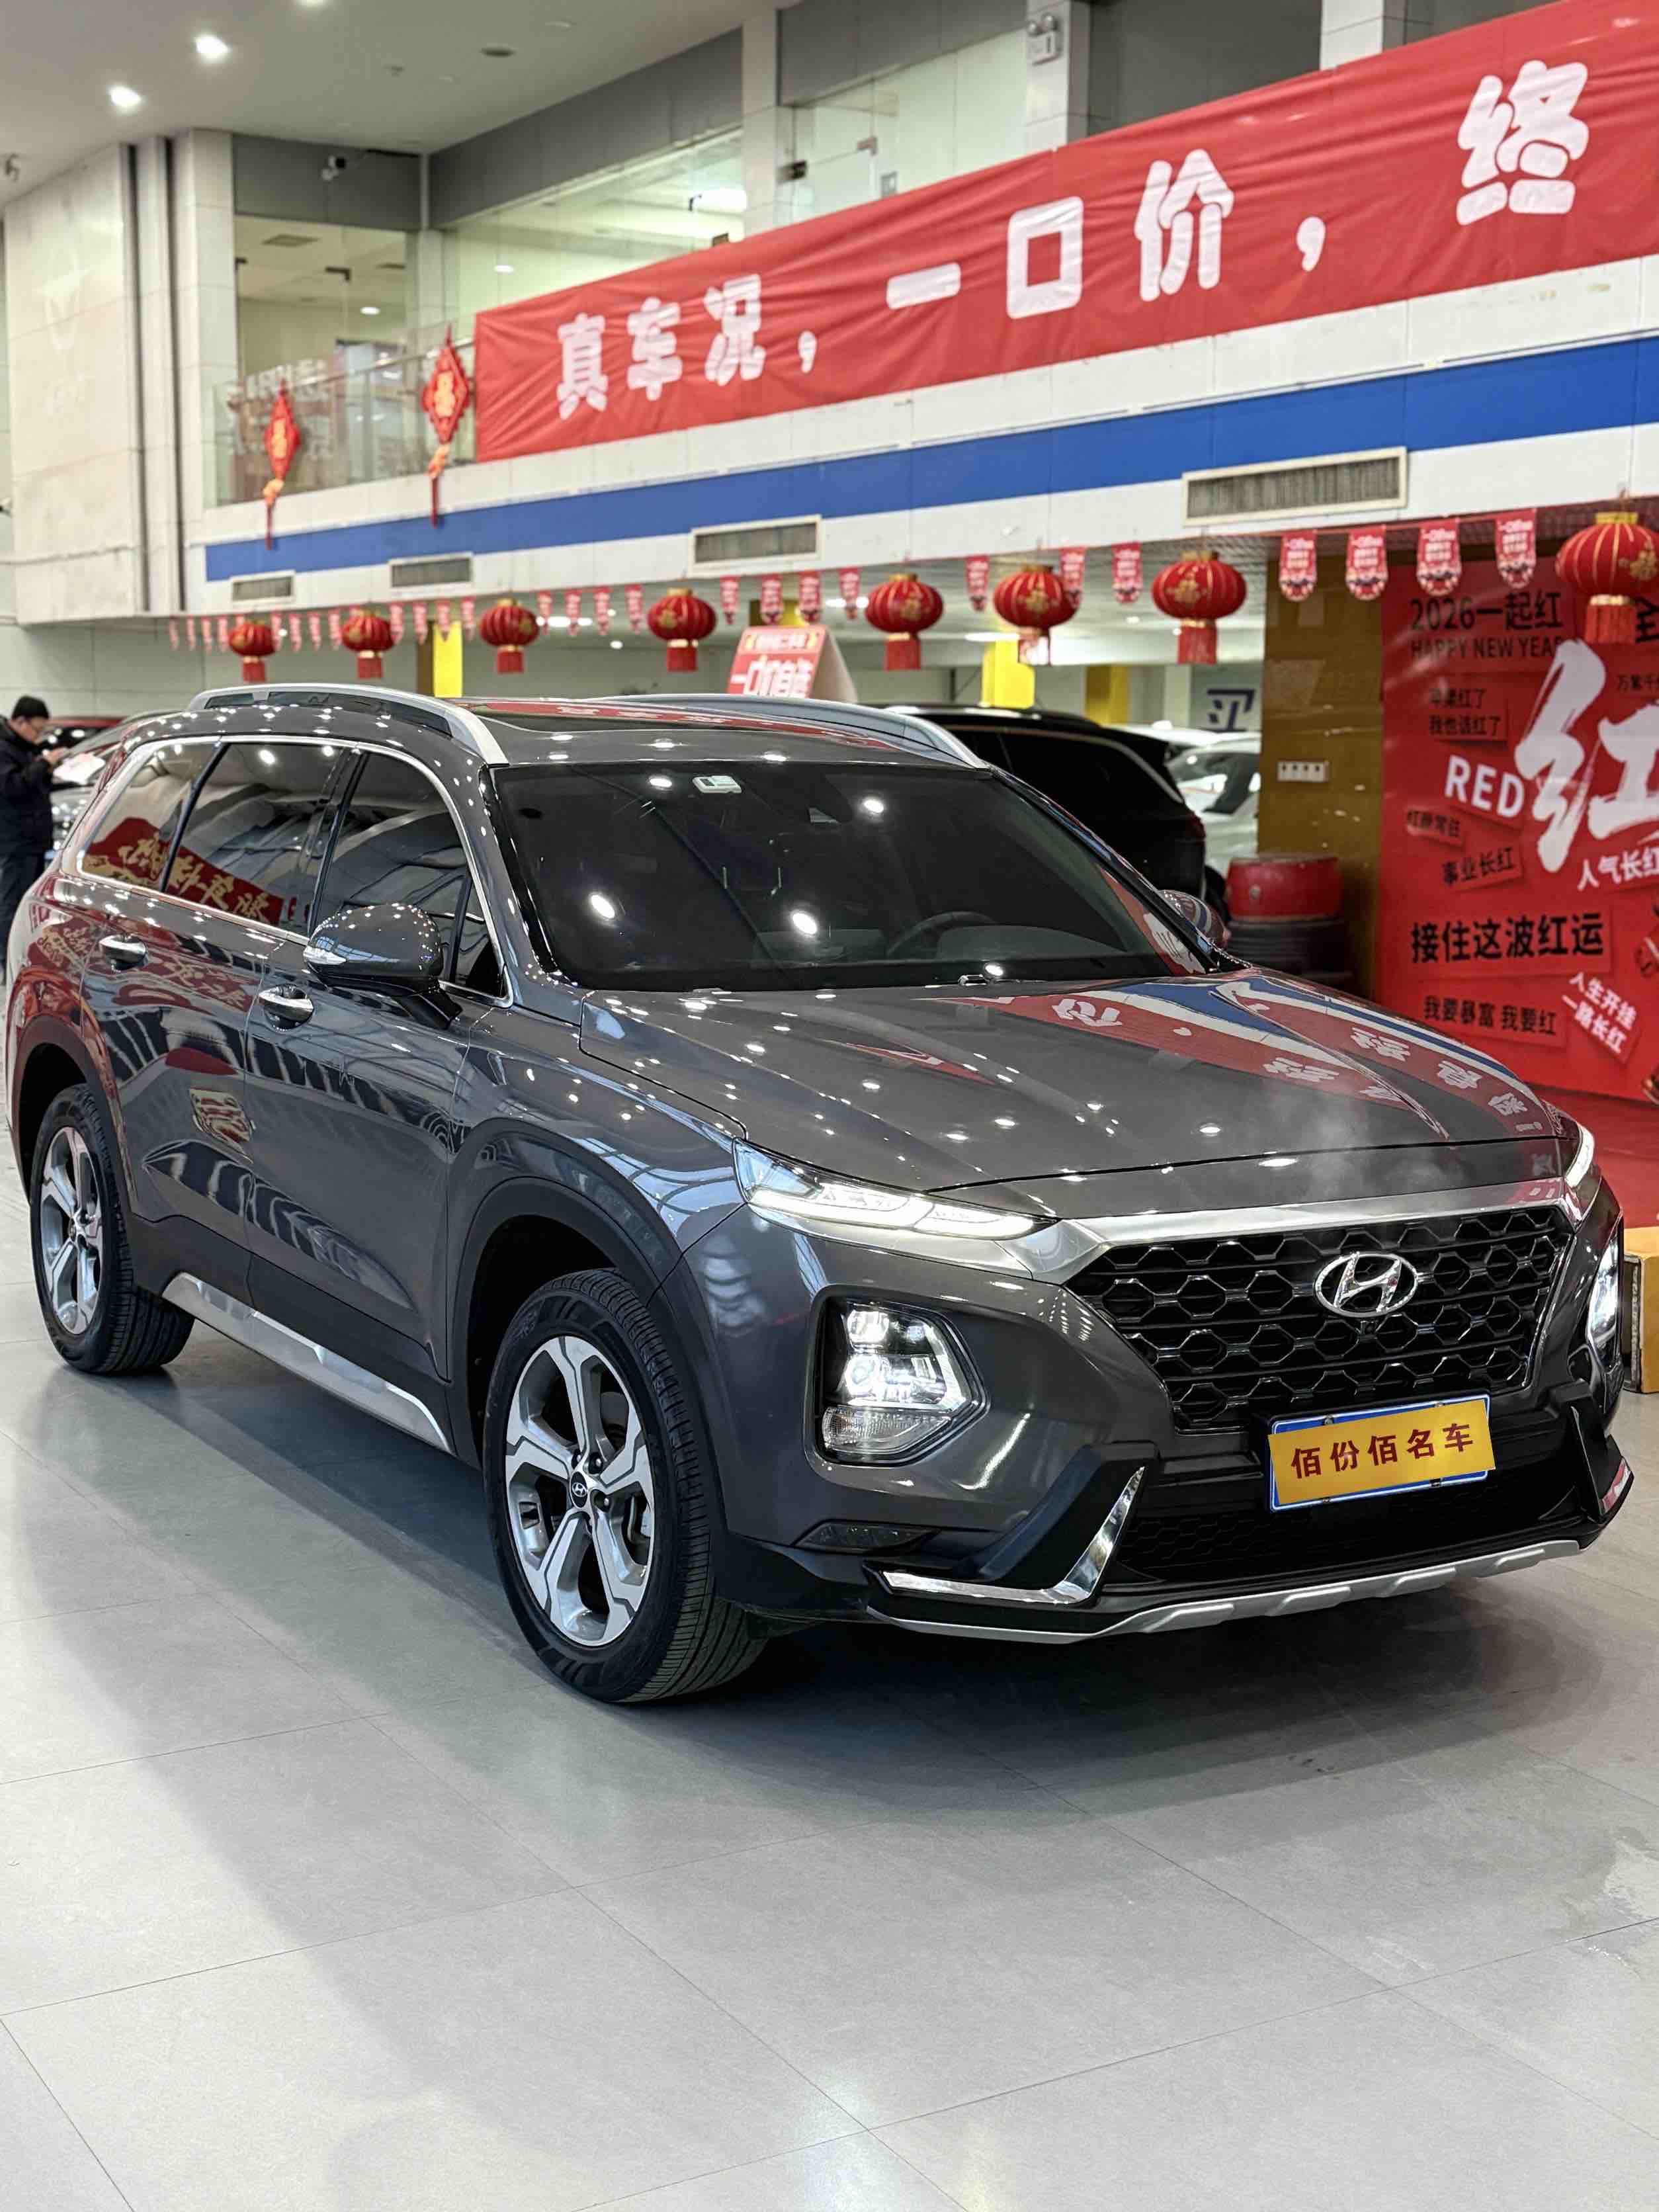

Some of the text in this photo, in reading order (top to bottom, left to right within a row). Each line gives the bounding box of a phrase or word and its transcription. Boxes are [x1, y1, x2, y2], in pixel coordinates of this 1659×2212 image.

[556, 60, 1589, 420] 真车况，一口价，终
[1410, 589, 1563, 630] 2026一起红
[1473, 636, 1513, 657] NEW
[1445, 755, 1524, 818] RED
[1411, 913, 1604, 963] 接住这波红运
[1424, 995, 1556, 1037] 我要暴富 我要红
[1291, 1422, 1474, 1479] 佰份佰名车
